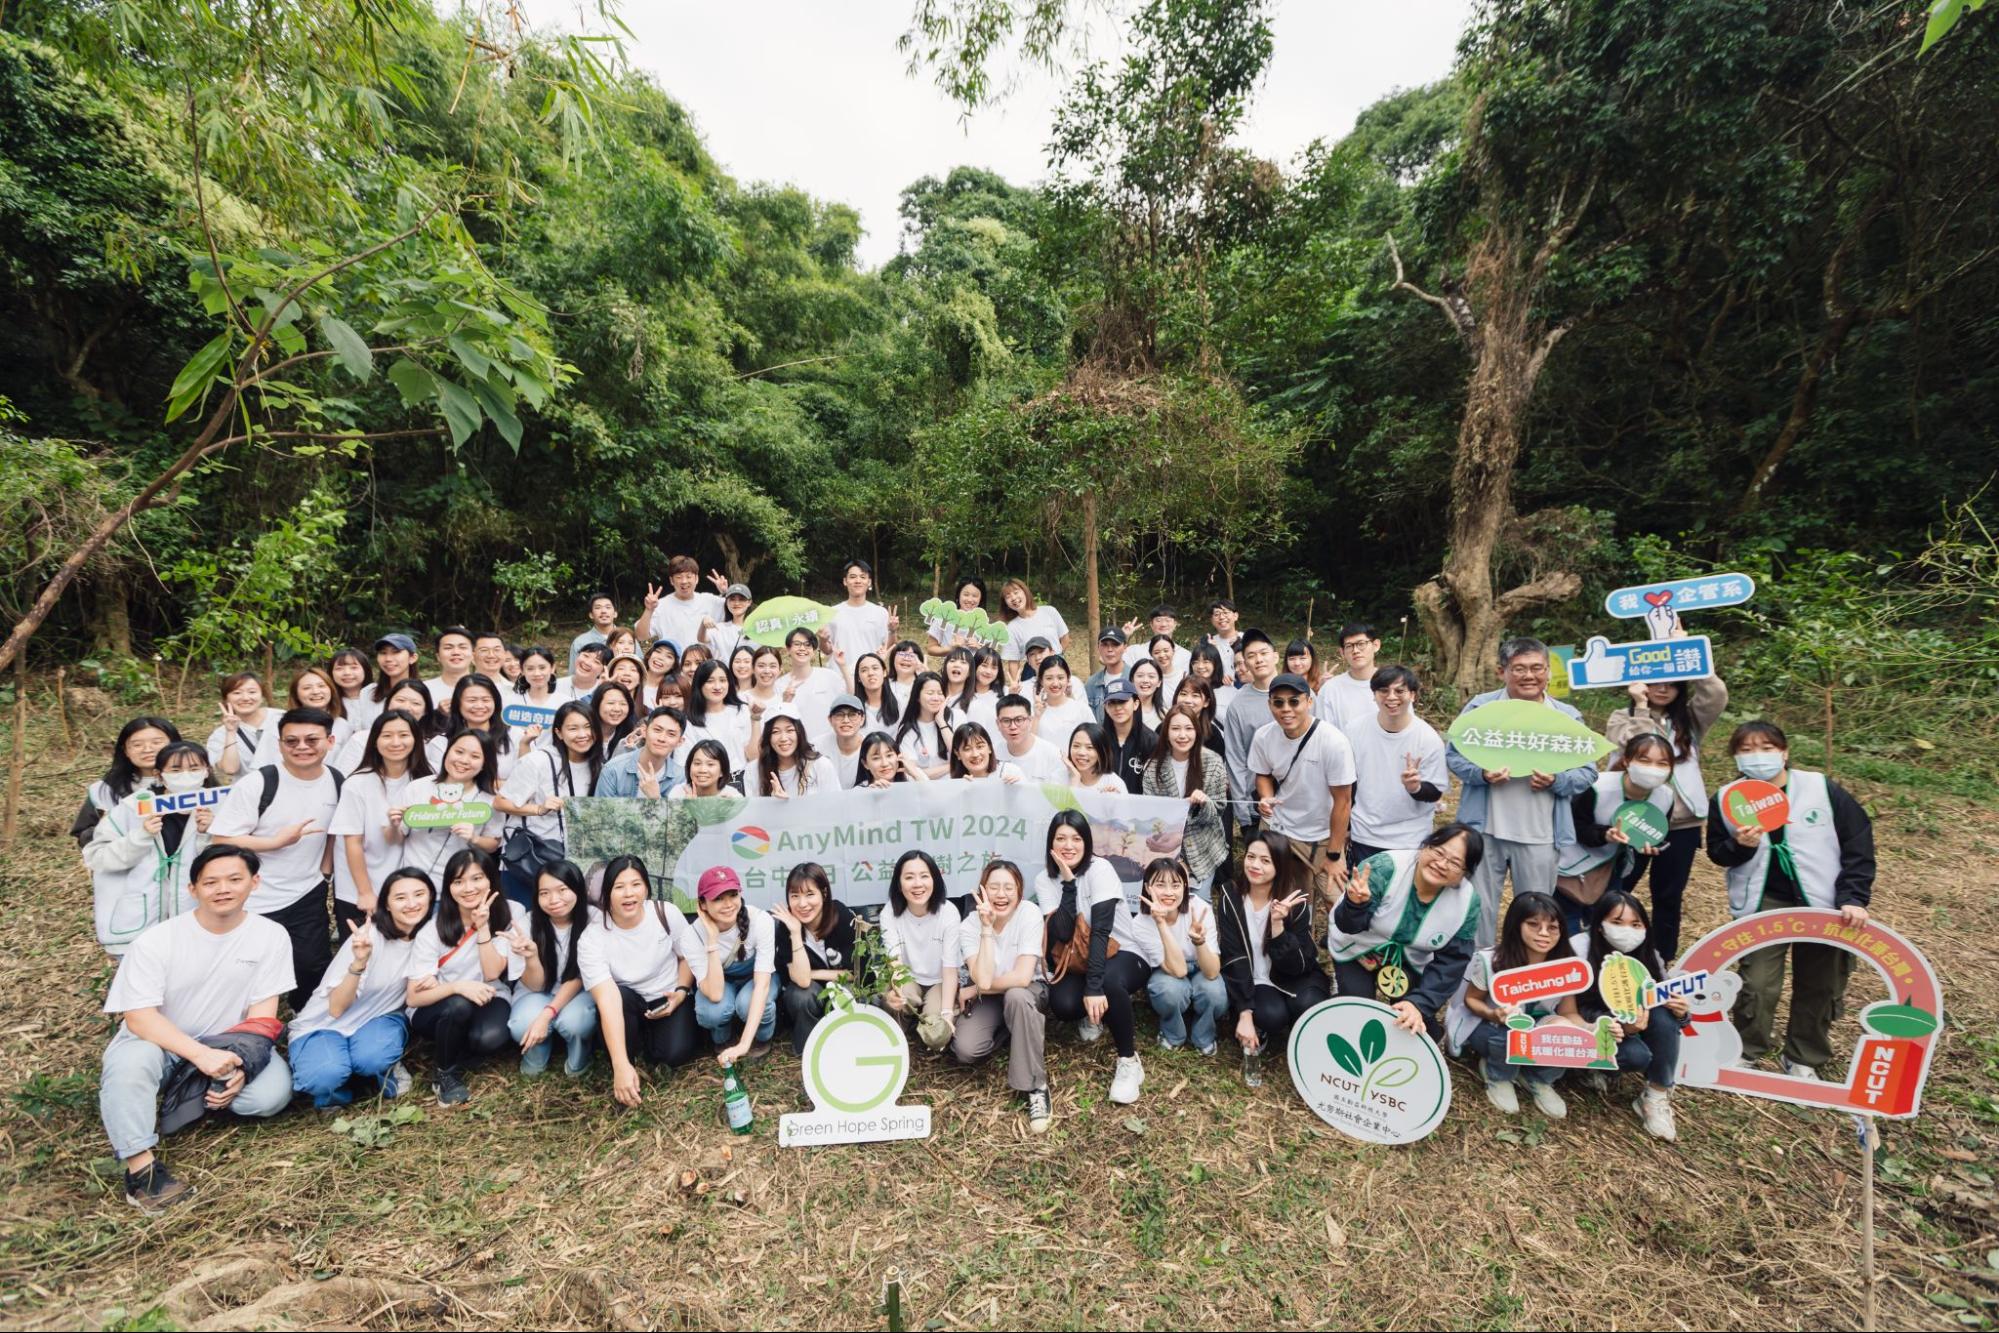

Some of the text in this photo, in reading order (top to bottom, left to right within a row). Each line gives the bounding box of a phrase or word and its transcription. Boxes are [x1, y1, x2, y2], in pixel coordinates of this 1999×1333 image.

[1618, 580, 1743, 611] 我 企管系
[1629, 645, 1672, 664] Good
[1462, 727, 1597, 755] 公益共好森林
[441, 811, 455, 820] For
[1735, 790, 1784, 819] Taiwan
[777, 814, 1028, 855] AnyMind TW 2024
[1624, 810, 1663, 840] Taiwan
[1499, 974, 1566, 997] Taichung
[1657, 973, 1707, 1003] NCUT
[1864, 1046, 1896, 1105] NCUT
[1320, 1072, 1361, 1094] NCUT
[1370, 1089, 1408, 1113] YSBC
[786, 1115, 925, 1138] Green Hope Spring
